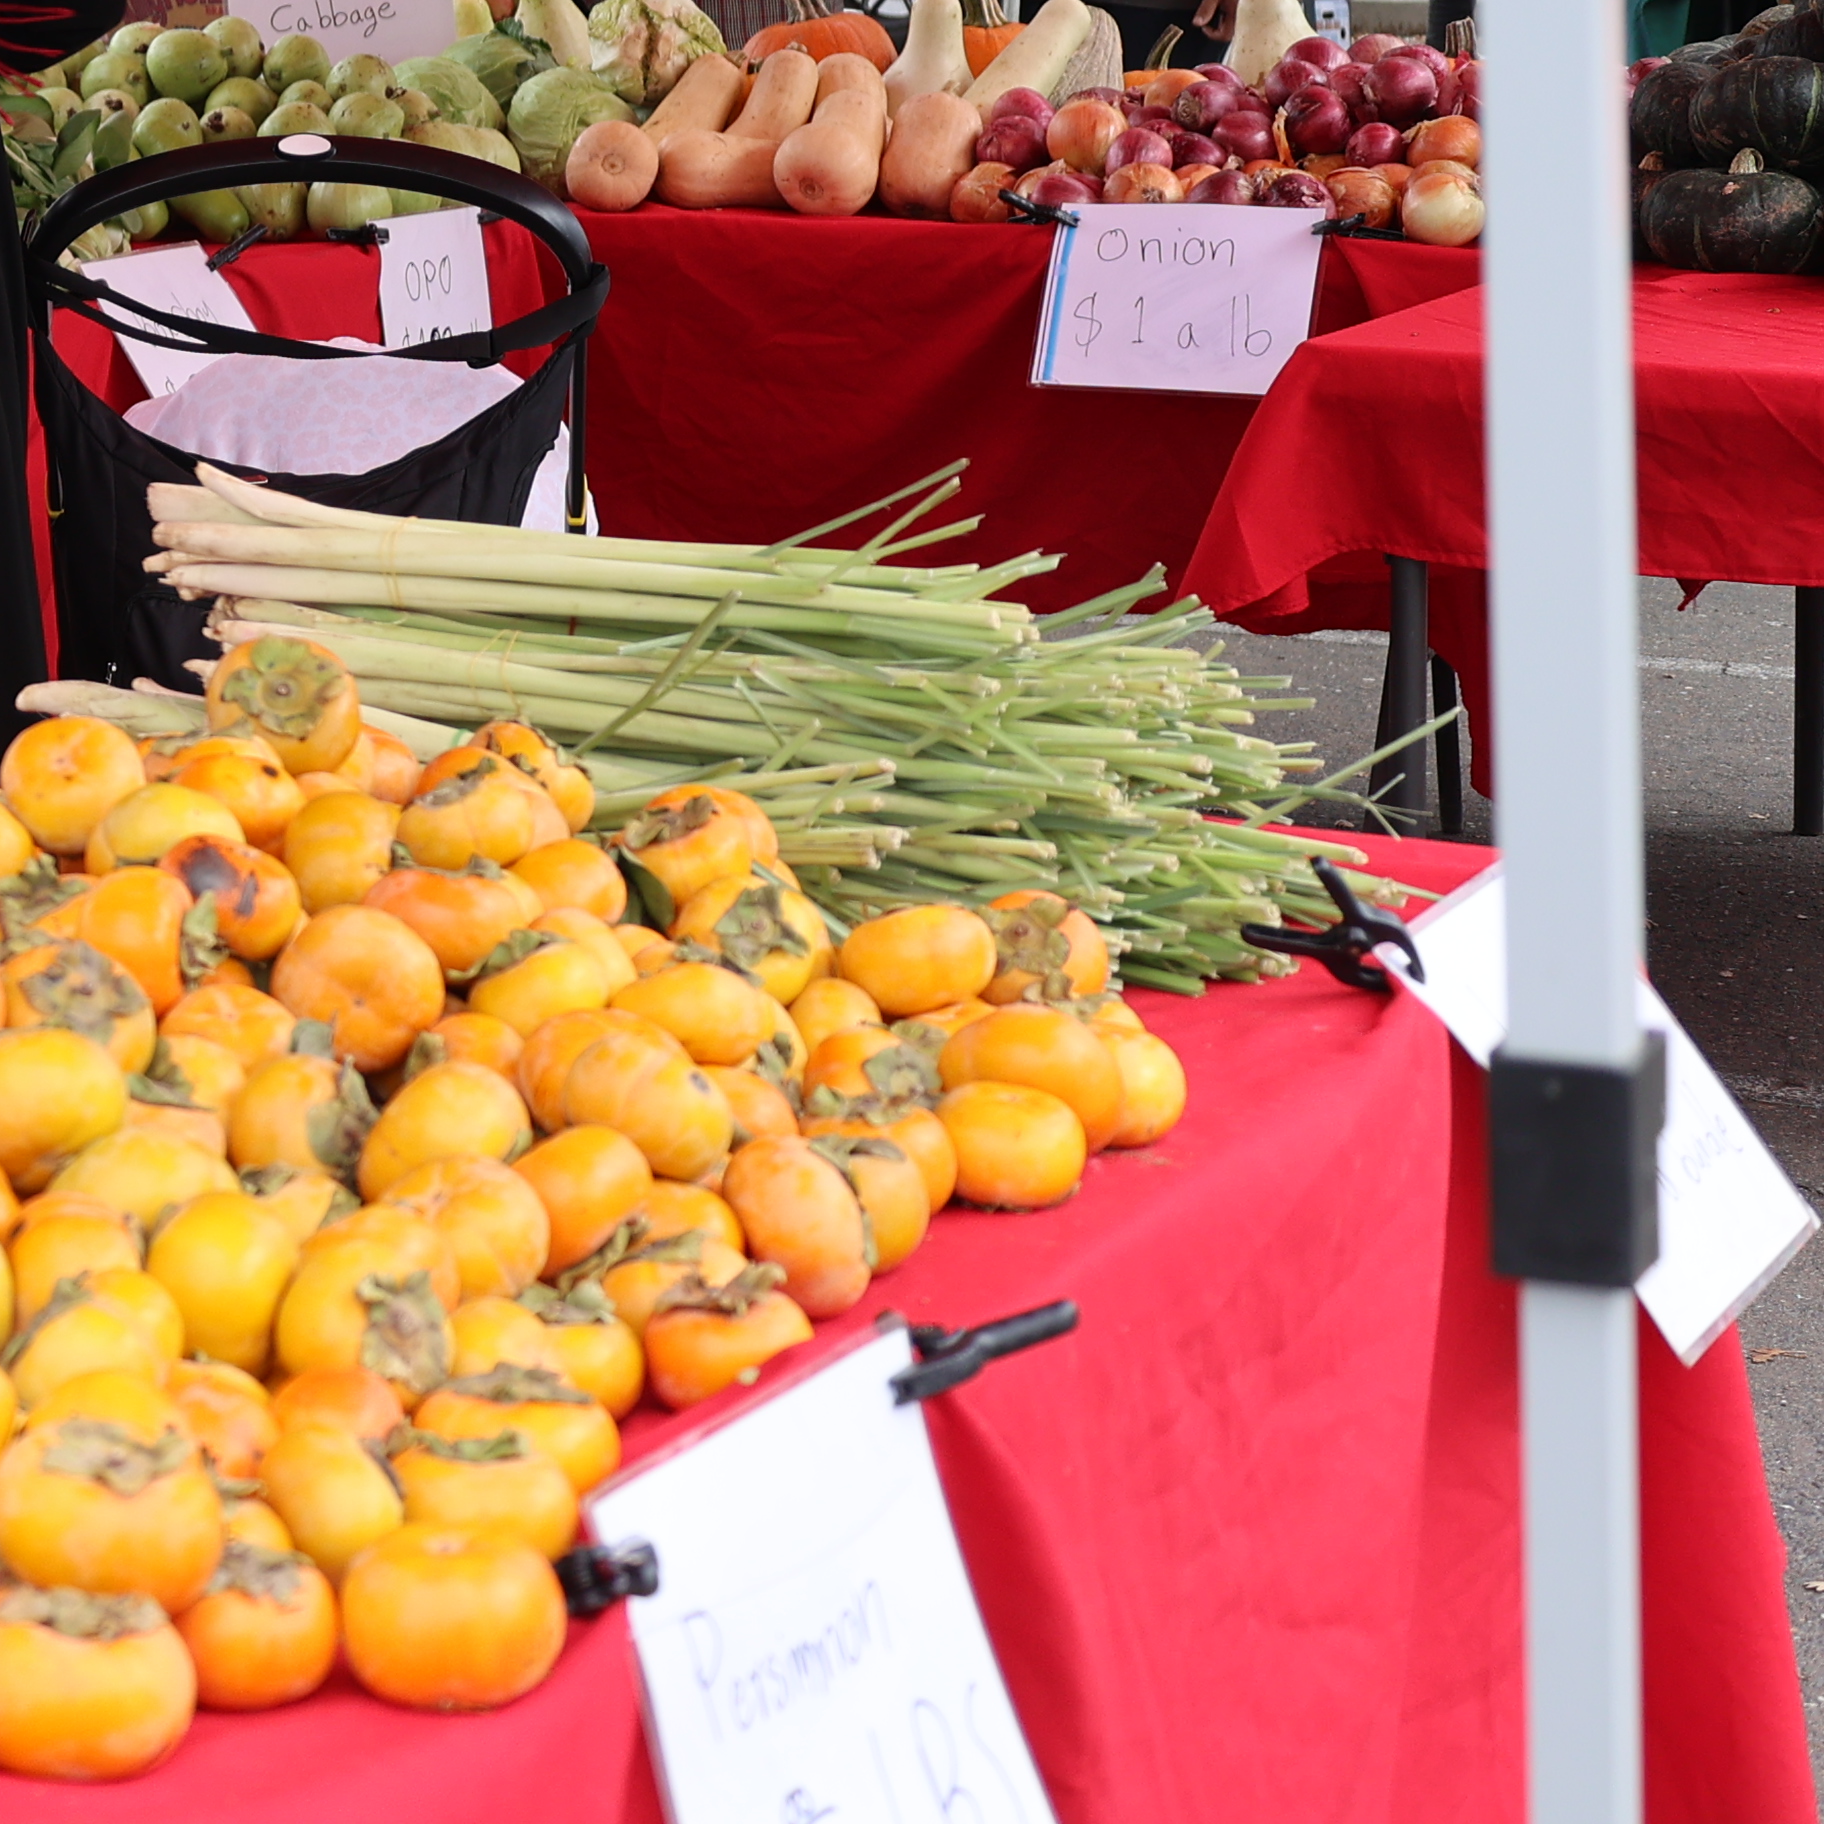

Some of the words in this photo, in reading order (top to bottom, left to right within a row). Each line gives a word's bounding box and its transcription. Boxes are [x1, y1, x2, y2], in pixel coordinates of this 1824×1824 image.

[1097, 227, 1235, 267] Onion
[405, 255, 452, 302] OPO
[1177, 322, 1200, 350] a
[1230, 293, 1273, 358] lb
